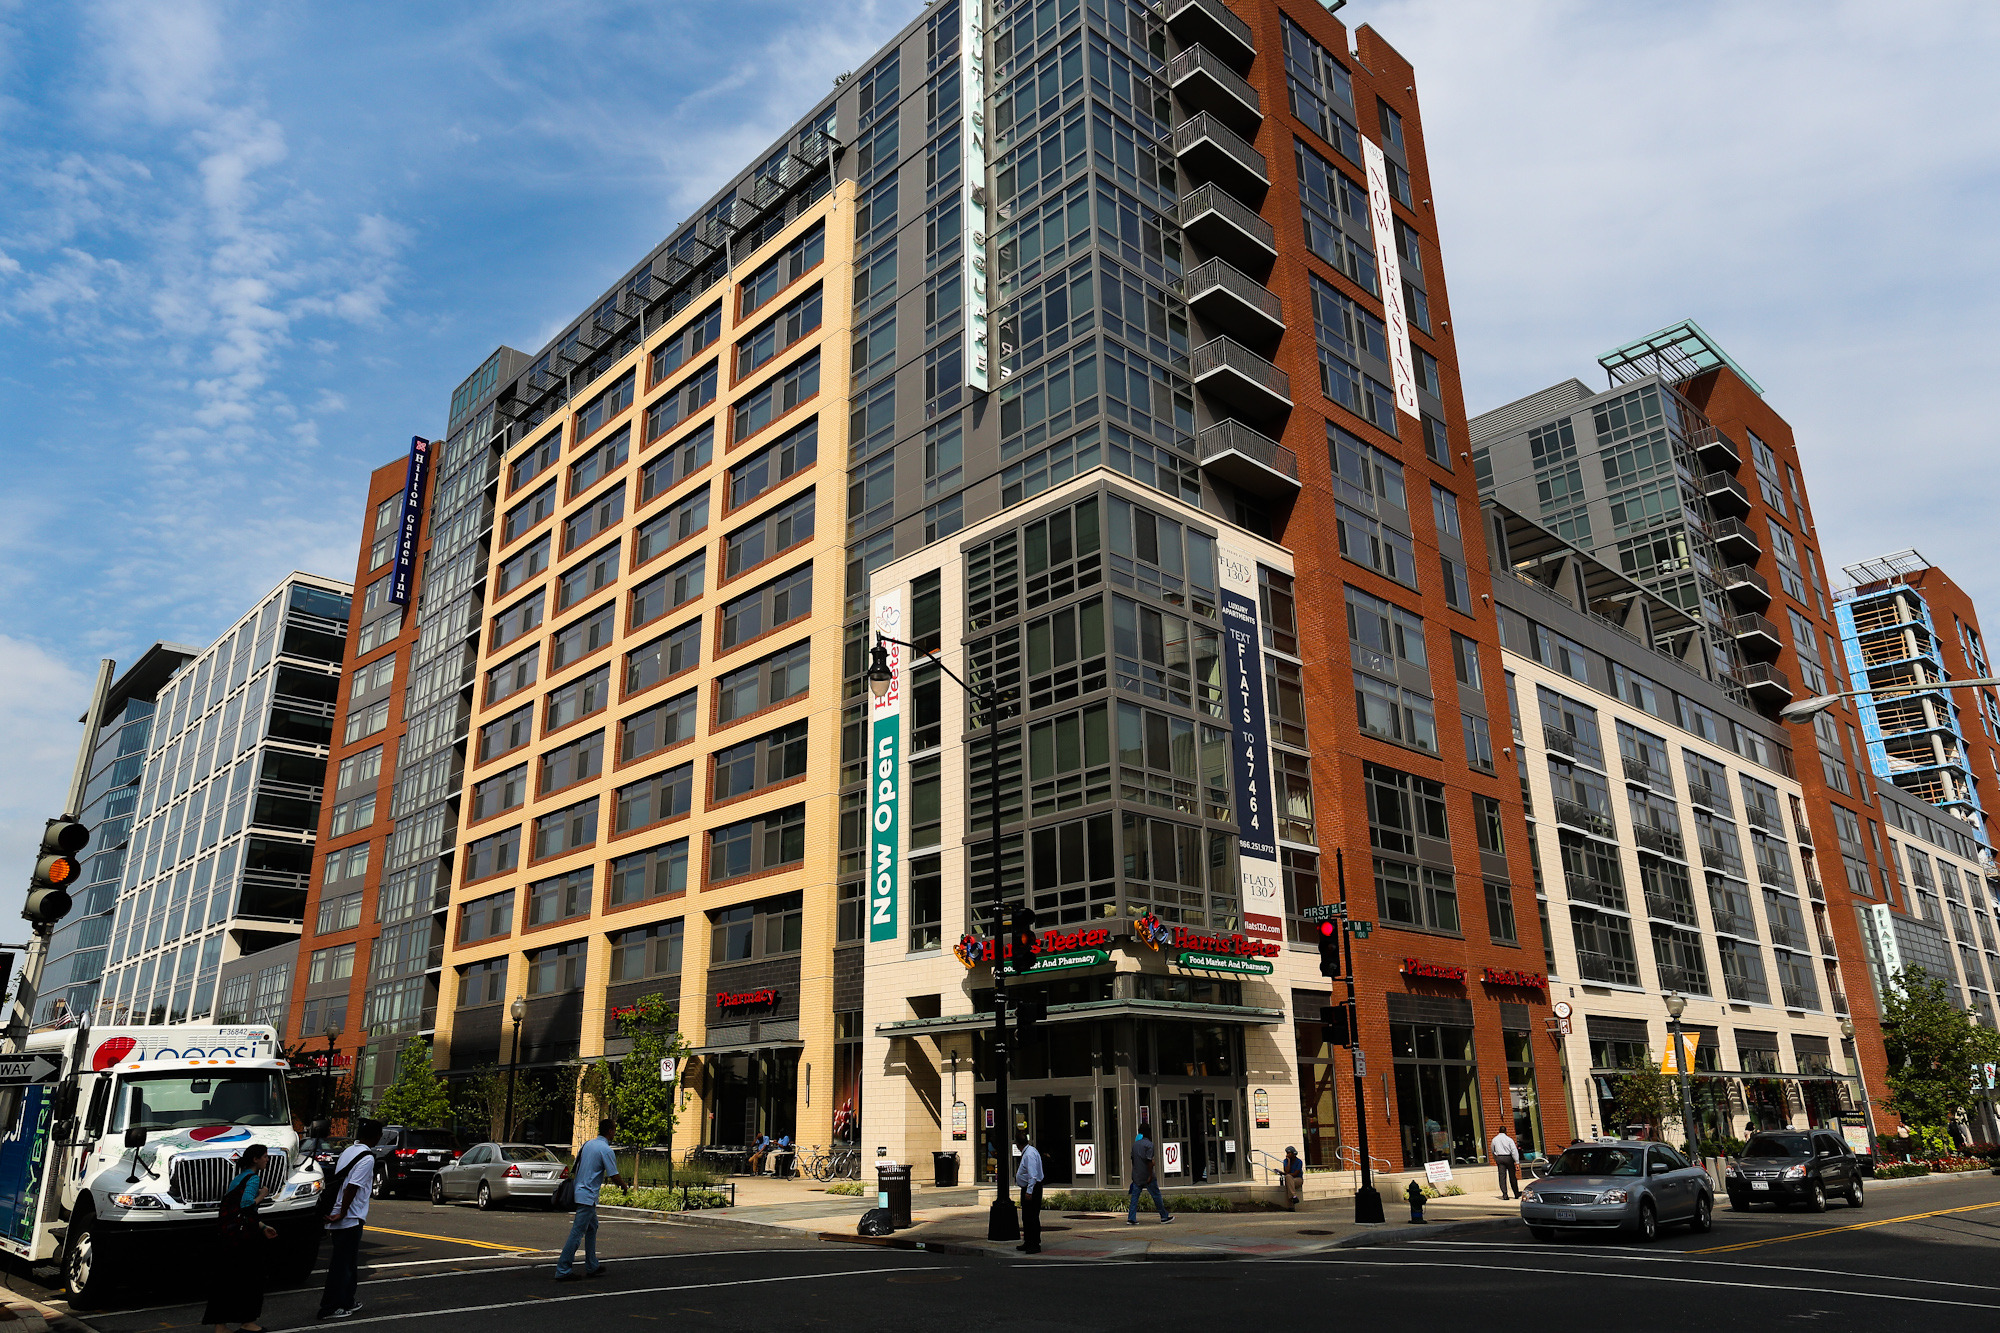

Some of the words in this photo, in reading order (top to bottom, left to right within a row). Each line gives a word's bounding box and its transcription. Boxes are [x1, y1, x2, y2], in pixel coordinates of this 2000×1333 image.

[1370, 166, 1390, 233] NOW
[1381, 243, 1414, 407] LEASING
[973, 230, 988, 373] SQUARE
[409, 453, 424, 508] Hilton
[400, 514, 415, 566] Garden
[1219, 555, 1250, 576] FLATS
[1227, 568, 1244, 583] 130
[396, 573, 405, 600] Inn
[1222, 607, 1256, 625] APARTMENTS
[1227, 601, 1249, 614] LUXURY
[1230, 628, 1251, 644] TEXT
[1238, 643, 1251, 723] FLATS
[1243, 731, 1255, 744] TO
[874, 736, 896, 833] Open
[1246, 746, 1260, 830] 47464
[873, 844, 892, 925] Now
[1243, 873, 1275, 889] FLATS
[1251, 886, 1268, 898] 130
[1303, 905, 1330, 918] FIRST
[1244, 921, 1281, 934] flats130.com
[1354, 922, 1362, 930] M
[1876, 908, 1895, 963] FLATS
[1044, 928, 1109, 952] Teeter
[1173, 926, 1230, 953] Harris
[1231, 933, 1281, 957] Teeter
[1042, 957, 1057, 968] And
[1058, 953, 1096, 967] Pharmacy
[1189, 955, 1205, 965] Food
[1206, 958, 1227, 968] Market
[1228, 960, 1241, 969] And
[1241, 962, 1271, 974] Pharmacy
[1405, 957, 1469, 986] Pharmacy
[1486, 967, 1517, 986] Fresh
[1517, 971, 1548, 989] Foods
[716, 989, 776, 1008] Pharmacy
[0, 1063, 31, 1075] WAY
